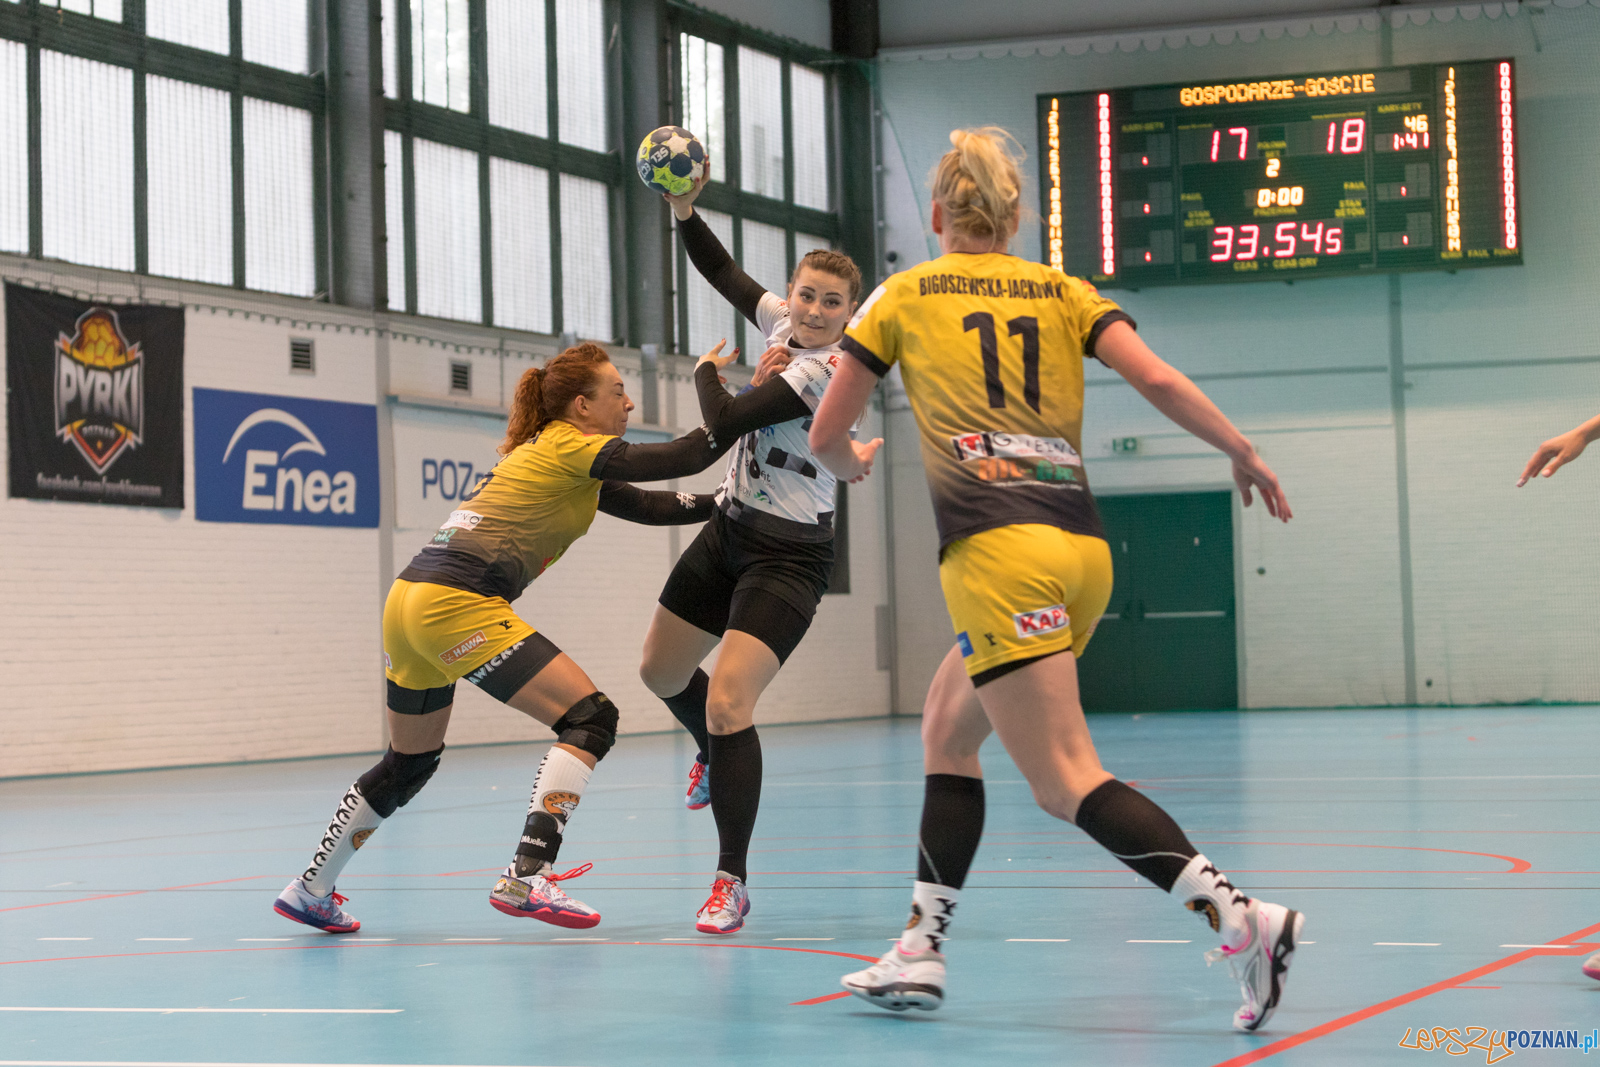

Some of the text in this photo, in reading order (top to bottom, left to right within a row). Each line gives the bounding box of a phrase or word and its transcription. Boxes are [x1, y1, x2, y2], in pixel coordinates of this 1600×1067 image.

[1326, 118, 1366, 154] 18
[1404, 114, 1429, 133] 46
[1210, 127, 1248, 161] 17
[1265, 157, 1281, 178] 2
[1257, 186, 1304, 208] 0:00
[962, 311, 1041, 415] 11
[60, 357, 140, 425] PYRKI
[242, 449, 356, 514] Enea
[453, 635, 484, 658] HAWA
